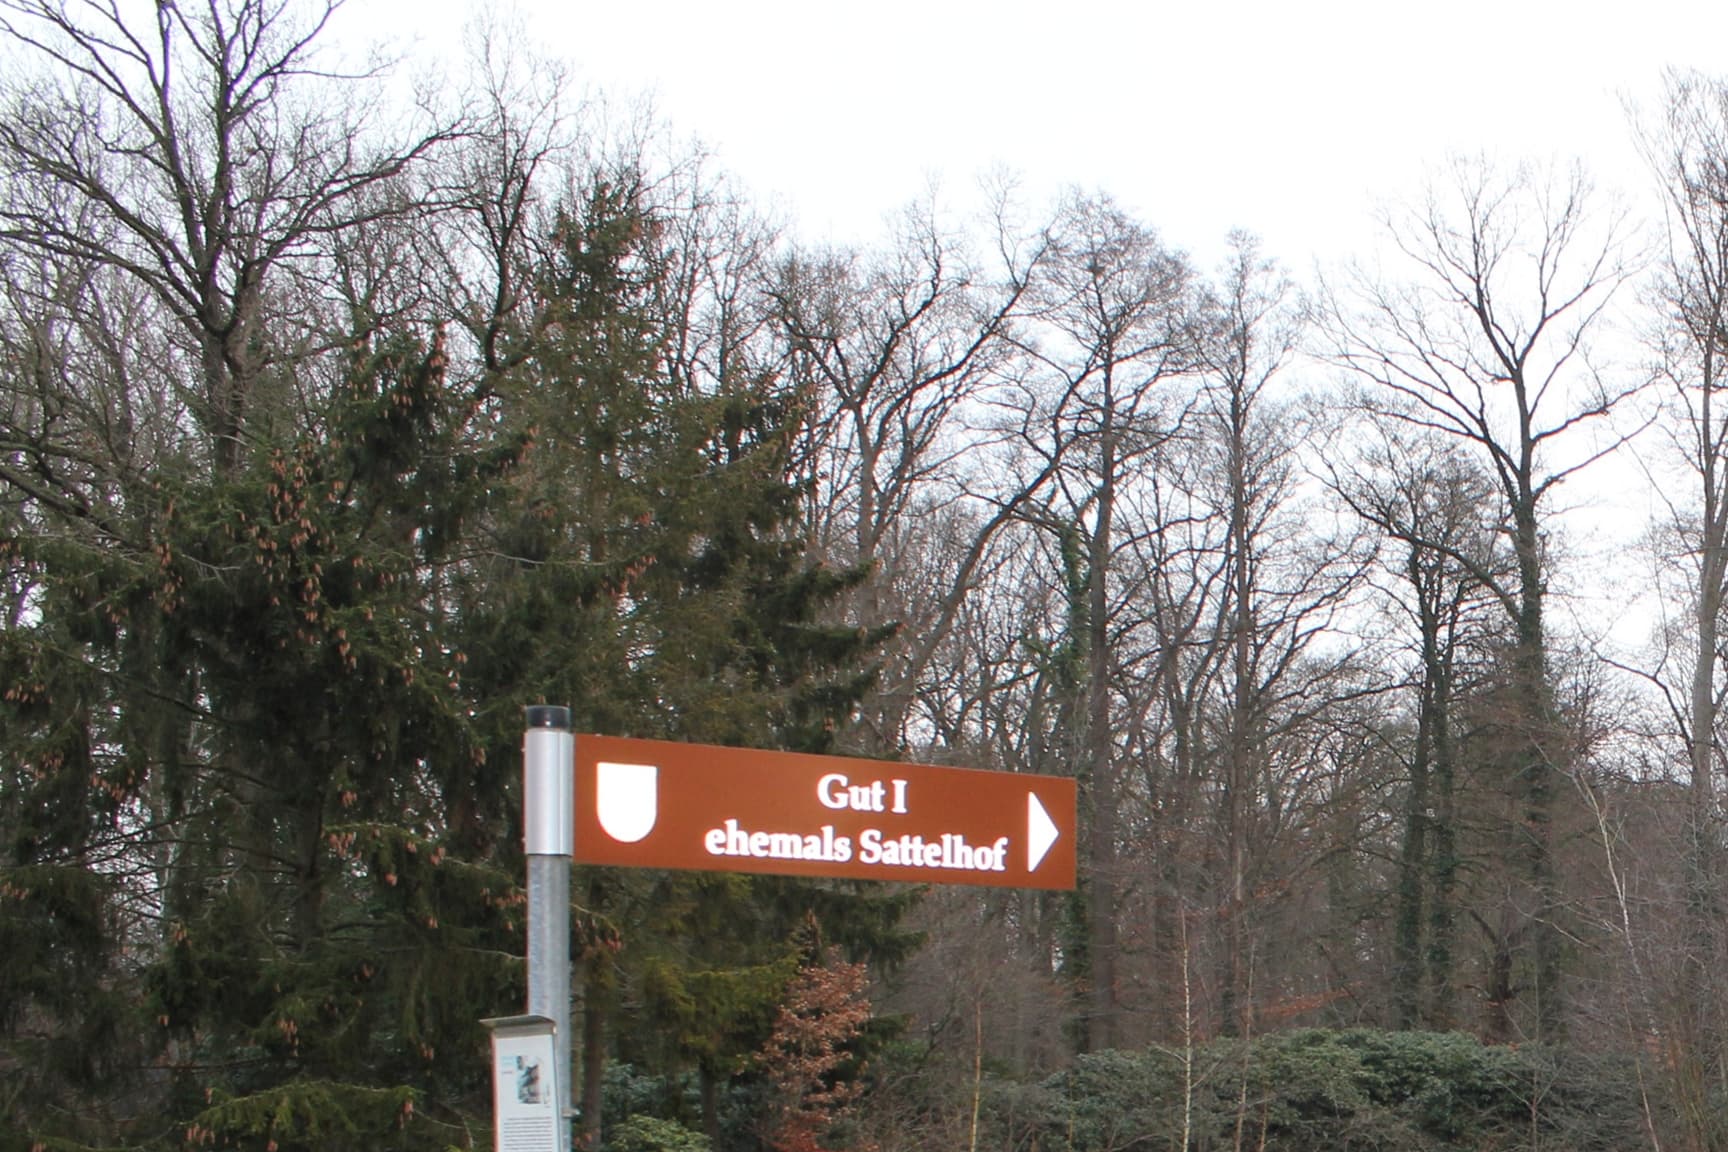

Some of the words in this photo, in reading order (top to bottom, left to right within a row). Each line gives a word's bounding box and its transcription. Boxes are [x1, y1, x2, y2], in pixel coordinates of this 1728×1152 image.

[817, 773, 886, 813] Gut
[891, 779, 908, 814] I
[704, 818, 853, 863] ehemals
[859, 828, 1009, 872] Sattelhof
